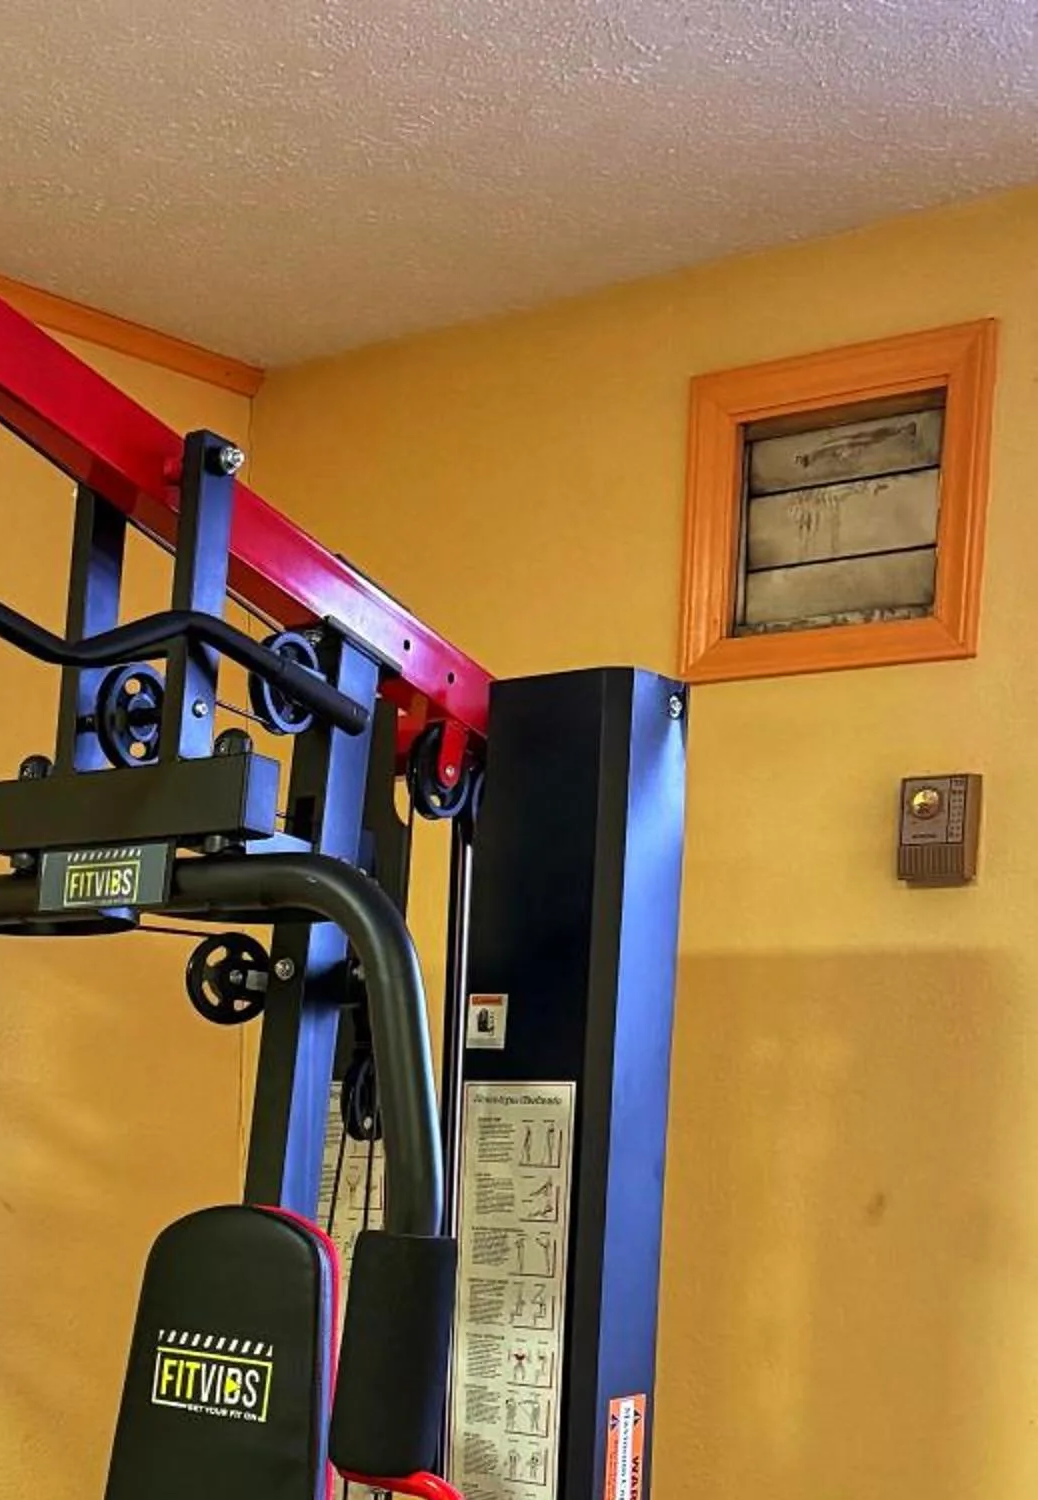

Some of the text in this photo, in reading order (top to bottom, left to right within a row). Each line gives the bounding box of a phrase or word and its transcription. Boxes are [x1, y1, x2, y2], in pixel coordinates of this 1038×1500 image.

[69, 867, 133, 899] FITVIBS
[160, 1358, 260, 1408] FITVIBS
[205, 1406, 228, 1417] YOUR
[229, 1409, 242, 1419] FIT
